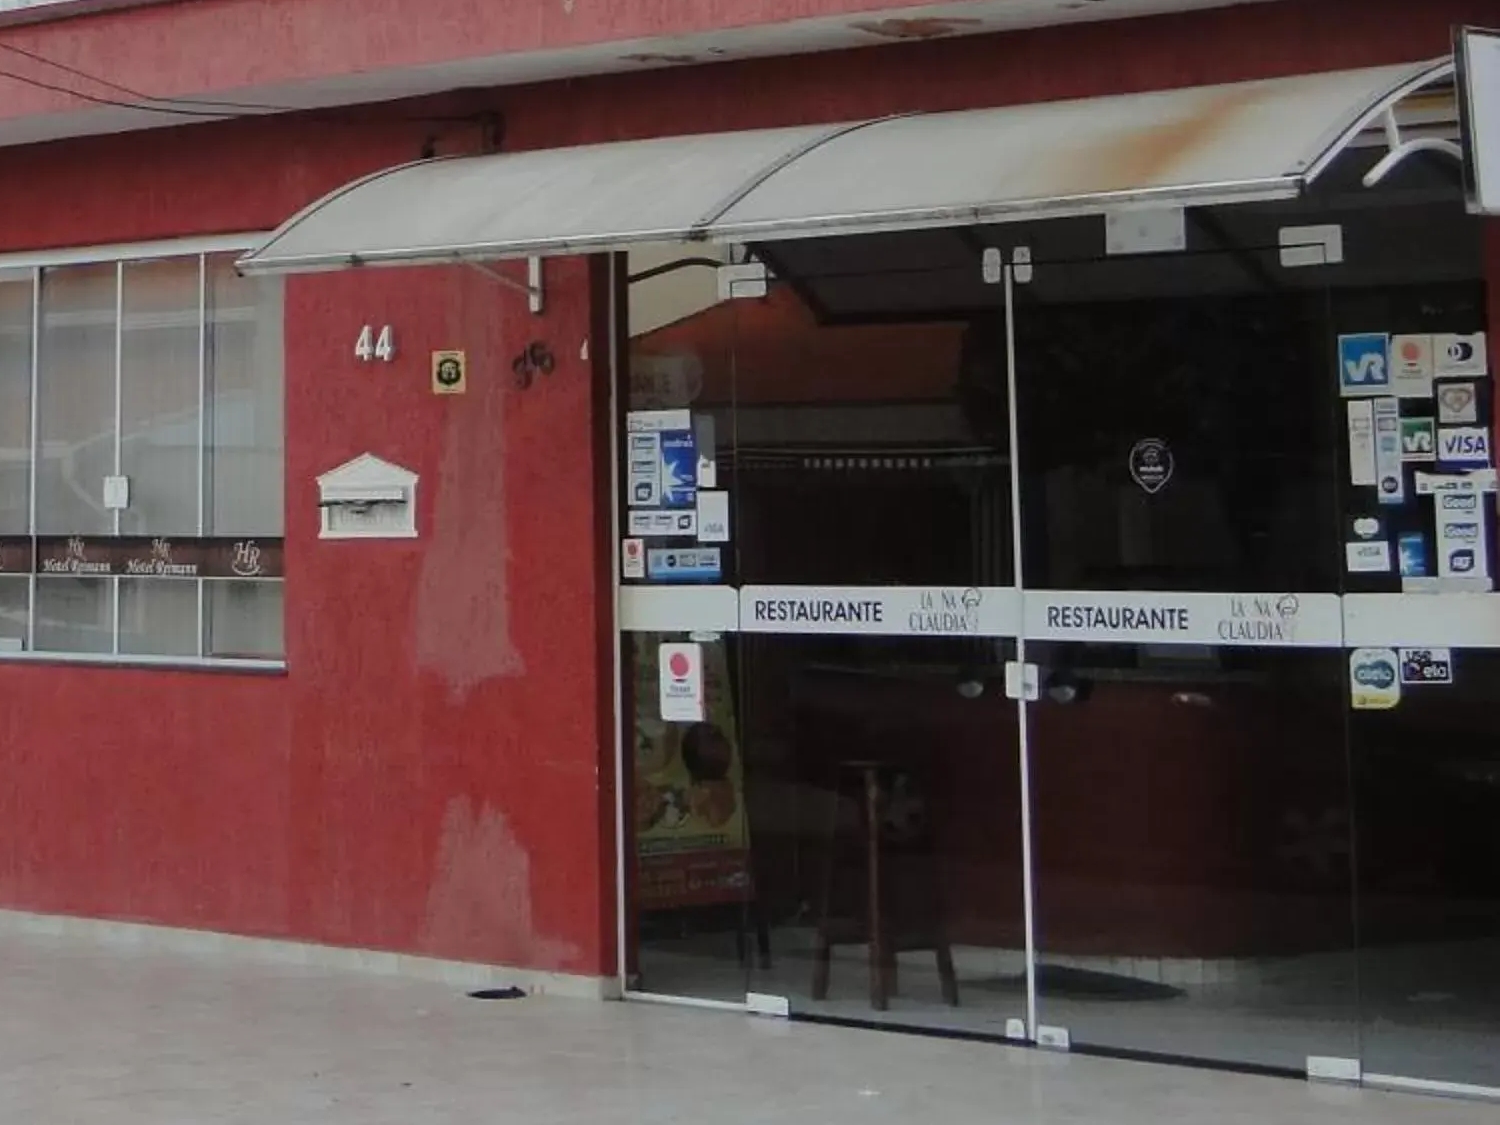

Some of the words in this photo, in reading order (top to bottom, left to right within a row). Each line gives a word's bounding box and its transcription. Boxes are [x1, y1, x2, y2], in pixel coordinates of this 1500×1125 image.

[355, 325, 394, 362] 44
[1445, 435, 1487, 454] VISA
[754, 599, 883, 623] RESTAURANTE
[908, 611, 968, 632] CLAUDIA
[1046, 605, 1190, 632] RESTAURANTE
[1217, 619, 1283, 641] CLAUDIA
